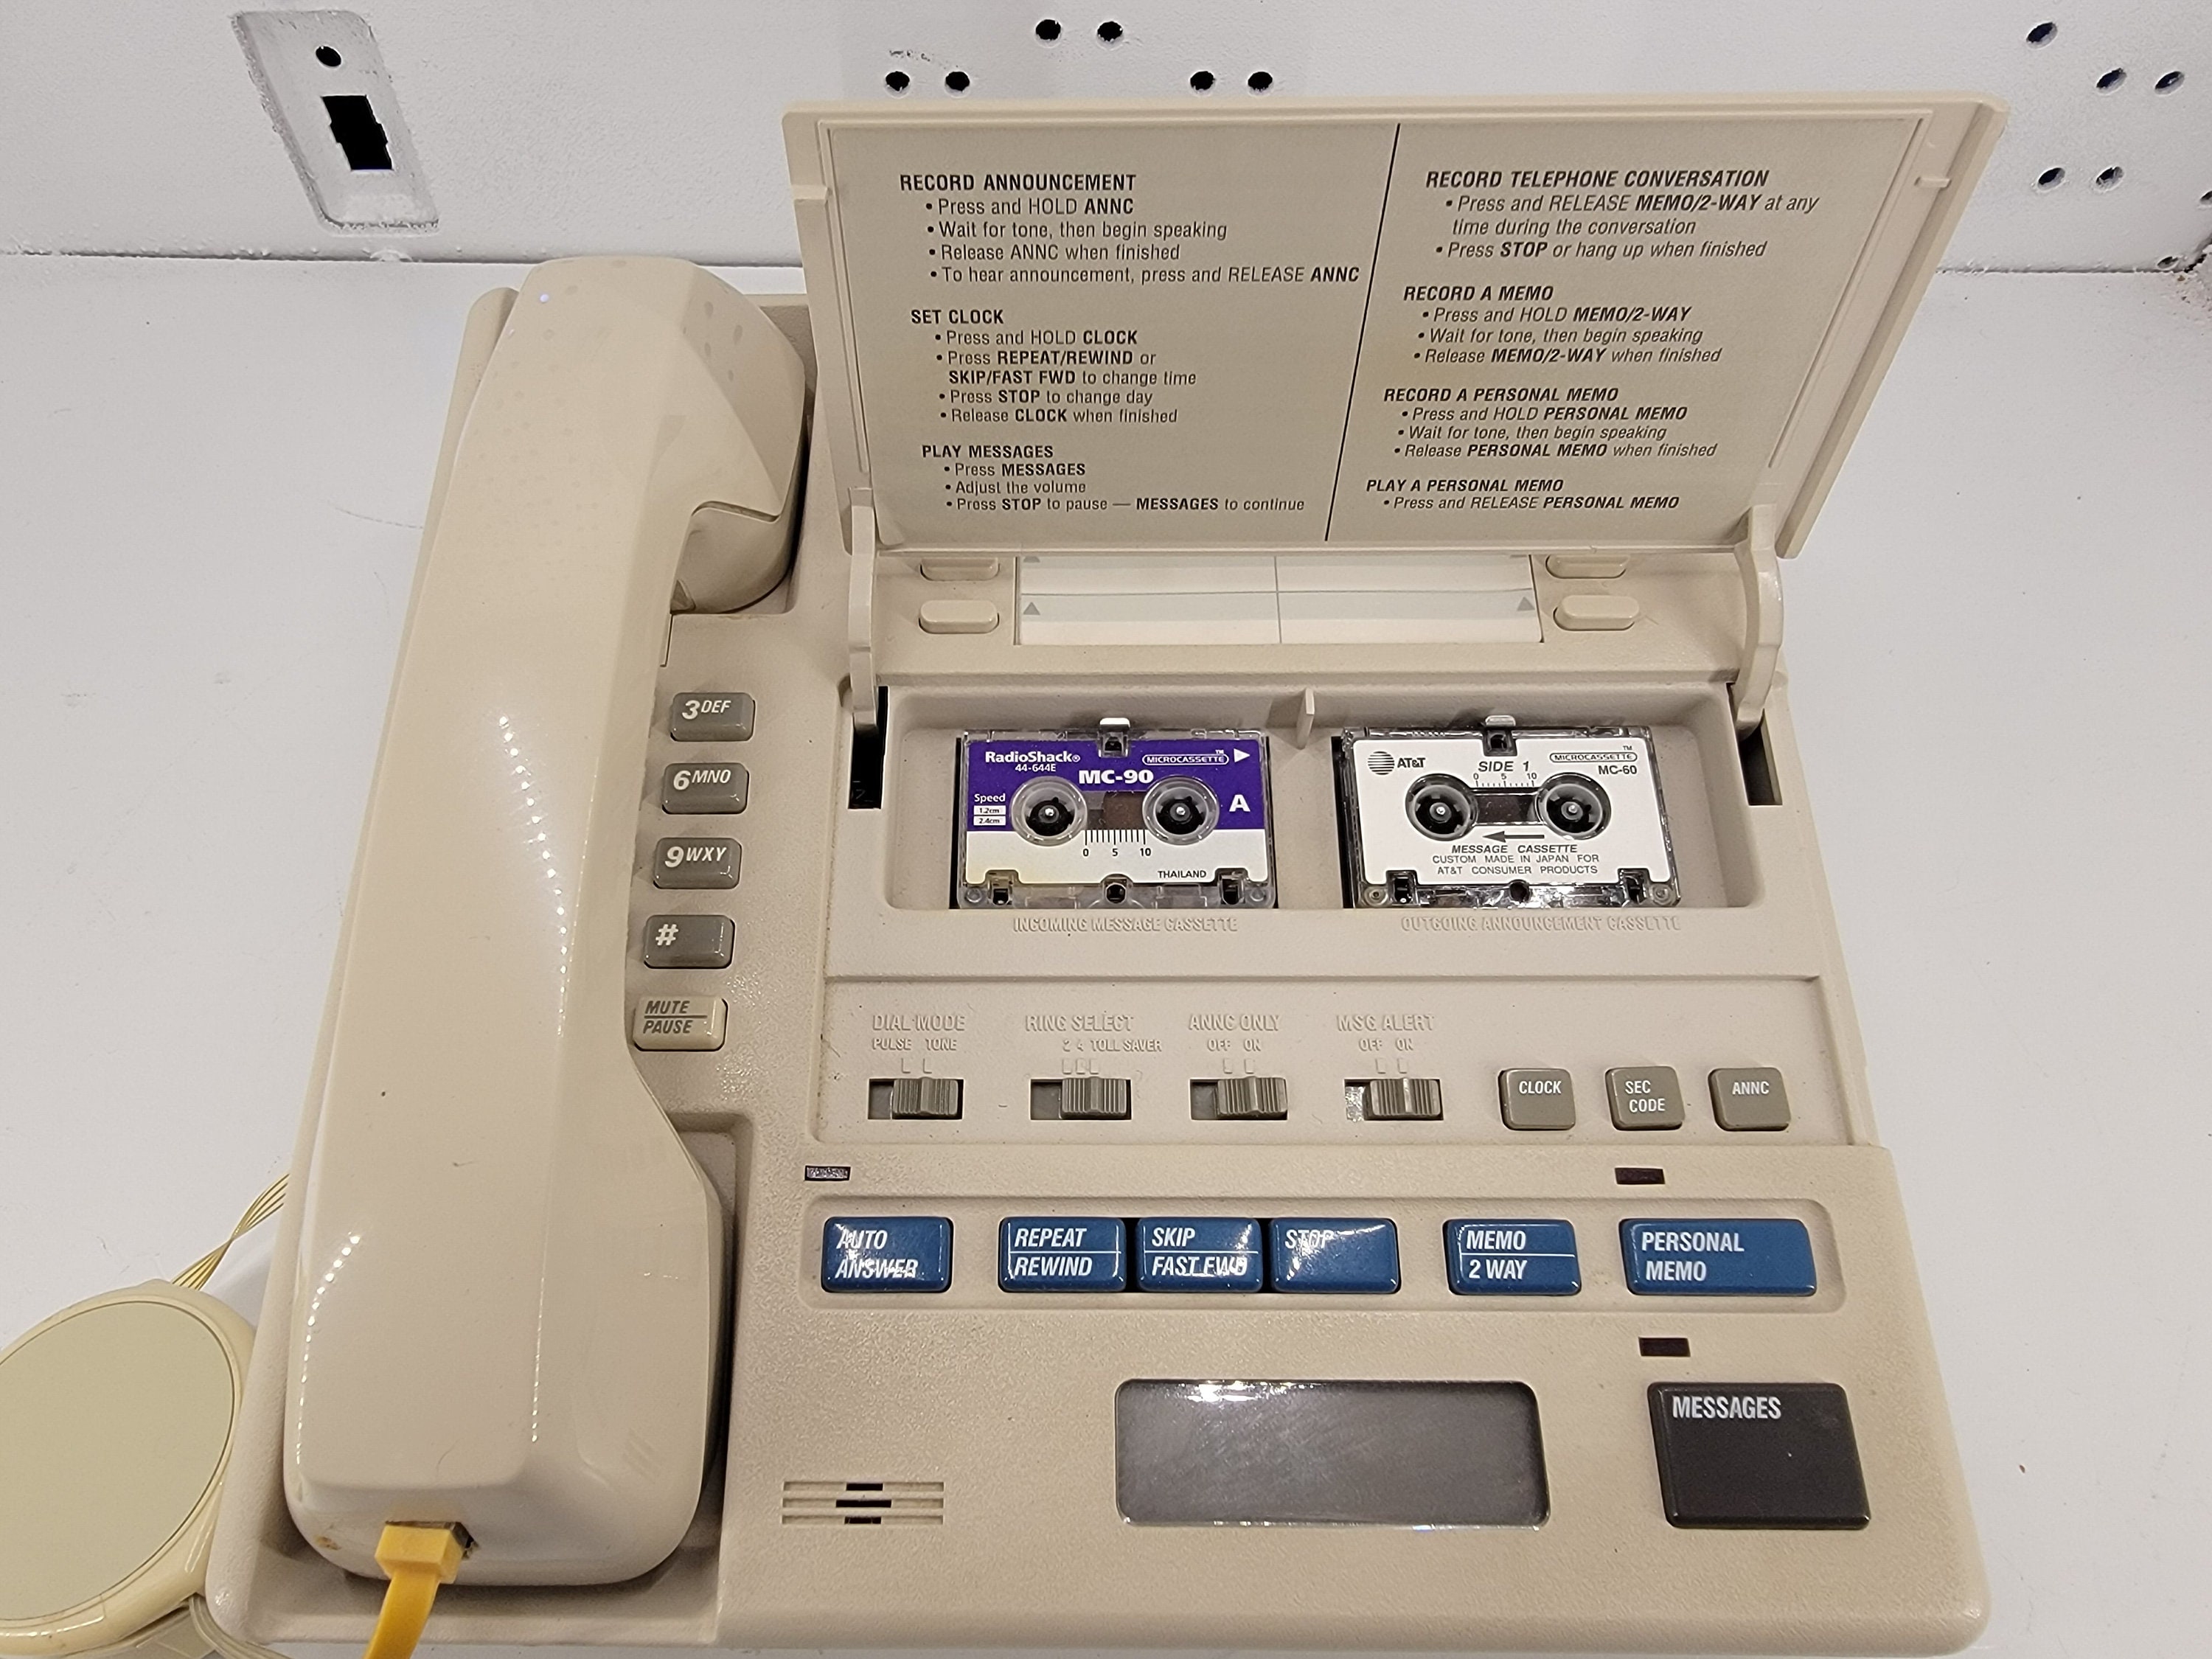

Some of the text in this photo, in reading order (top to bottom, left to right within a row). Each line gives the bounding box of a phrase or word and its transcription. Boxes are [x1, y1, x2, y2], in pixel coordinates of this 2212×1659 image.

[900, 173, 1136, 191] RECORD ANNOUNCEMENT
[1426, 170, 1770, 188] RECORD TELEPHONE CONVERSATION
[939, 198, 1133, 215] Press and HOLD ANNC
[1458, 194, 1820, 214] Press and RELEASE MEMO/2-WAY at any
[939, 220, 1226, 241] Wait for tone, then begin speaking
[1453, 218, 1696, 237] time during the conversation
[942, 243, 1180, 260] Release ANNC when finished
[942, 266, 1359, 285] To hear announcement, press and RELEASE ANNC
[1404, 285, 1554, 301] RECORD A MEMO
[911, 309, 1004, 324] SET CLOCK
[948, 350, 1156, 366] Press REPEAT/REWIND or
[949, 370, 1196, 387] SKIP/FAST FWD to change time
[1384, 388, 1618, 402] RECORD A PERSONAL MEMO
[1413, 407, 1687, 420] Press and HOLD PERSONAL MEMO
[922, 445, 1053, 459] PLAY MESSAGES
[956, 462, 1085, 476] Press MESSAGES
[956, 480, 1085, 496] Adjust the volume
[1366, 479, 1563, 492] PLAY A PERSONAL MEMO
[1146, 755, 1226, 763] MICROCASSETTE
[1397, 757, 1426, 769] AT&T
[1554, 754, 1633, 762] MICROCASSETTE
[1015, 764, 1057, 773] 44-644E
[1478, 761, 1530, 772] SIDE 1
[1598, 765, 1638, 775] MC-60
[1078, 770, 1154, 785] MC-90
[974, 793, 1006, 804] Speed
[1228, 794, 1251, 812] A
[1082, 848, 1152, 857] 0 5 10
[1451, 844, 1578, 853] MESSAGE CASSETTE
[1432, 855, 1599, 863] CUSTOM MADE IN JAPAN FOR
[1158, 870, 1206, 878] THAILAND
[1472, 866, 1531, 874] CONSUMER
[1540, 866, 1598, 874] PRODUCTS
[1012, 917, 1238, 933] INCOMING MESSAGE CASSETTE
[1401, 916, 1681, 932] OUTGOING ANNOUNCEMENT CASSETTE
[644, 1000, 690, 1015] MUTE
[643, 1019, 692, 1034] PAUSE
[872, 1014, 966, 1032] DIAL MODE
[1026, 1015, 1134, 1032] RING SELECT
[1189, 1014, 1280, 1032] ANNC ONLY
[1337, 1014, 1436, 1032] MSG ALERT
[872, 1037, 957, 1051] PULSE TONE
[1091, 1038, 1120, 1051] TOLL
[1123, 1039, 1162, 1052] SAVER
[1207, 1038, 1262, 1051] OFF ON
[1359, 1038, 1413, 1051] OFF ON
[1519, 1080, 1562, 1094] CLOCK
[1624, 1079, 1651, 1094] SEC
[1732, 1082, 1770, 1095] ANNC
[1629, 1099, 1666, 1113] CODE
[835, 1229, 888, 1250] AUTO
[1014, 1228, 1086, 1247] REPEAT
[1151, 1228, 1195, 1247] SKIP
[1284, 1229, 1335, 1249] STOP
[1466, 1230, 1527, 1251] MEMO
[1641, 1231, 1745, 1252] PERSONAL
[835, 1259, 919, 1279] ANSWER
[1014, 1256, 1093, 1276] REWIND
[1151, 1256, 1248, 1276] FAST FWD
[1468, 1259, 1528, 1279] 2 WAY
[1645, 1261, 1707, 1281] MEMO
[1672, 1397, 1782, 1419] MESSAGES
